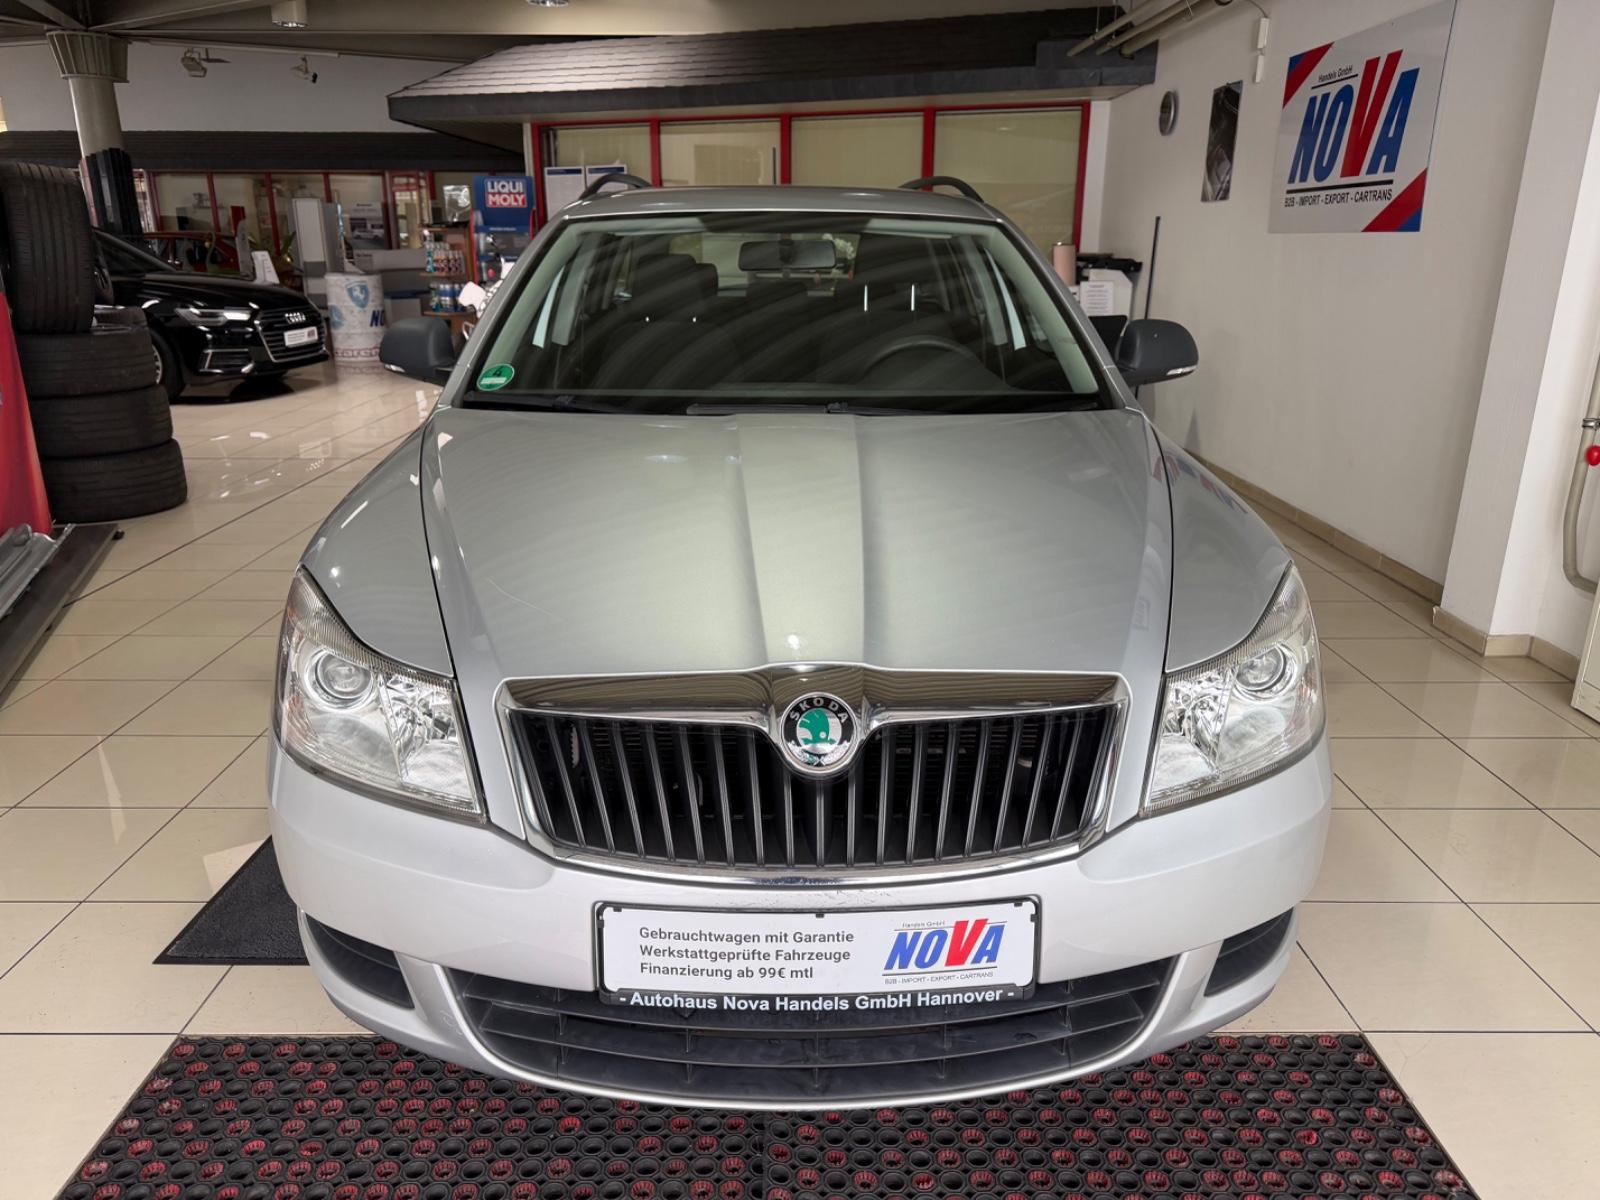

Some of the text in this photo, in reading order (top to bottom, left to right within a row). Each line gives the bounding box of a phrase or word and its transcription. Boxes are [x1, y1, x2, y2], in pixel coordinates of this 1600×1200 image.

[1288, 49, 1420, 184] NOVA
[487, 181, 523, 193] LIQUI
[488, 193, 525, 206] MOLY
[1299, 195, 1320, 206] IMPORT
[1325, 192, 1349, 205] EXPORT
[1354, 189, 1392, 202] CARTRANS
[640, 927, 854, 945] Gebrauchtwagen mit Garantie
[884, 918, 1005, 970] NOVA
[640, 945, 851, 963] Werkstattgeprüfte Fahrzeuge
[640, 962, 813, 980] Finanzierung ab 99€ mtl
[960, 971, 993, 979] CARTRANS
[630, 992, 717, 1009] Autohaus
[723, 996, 769, 1010] Nova
[775, 996, 849, 1011] Handels
[855, 993, 911, 1009] GmbH
[917, 989, 1003, 1007] Hannover
